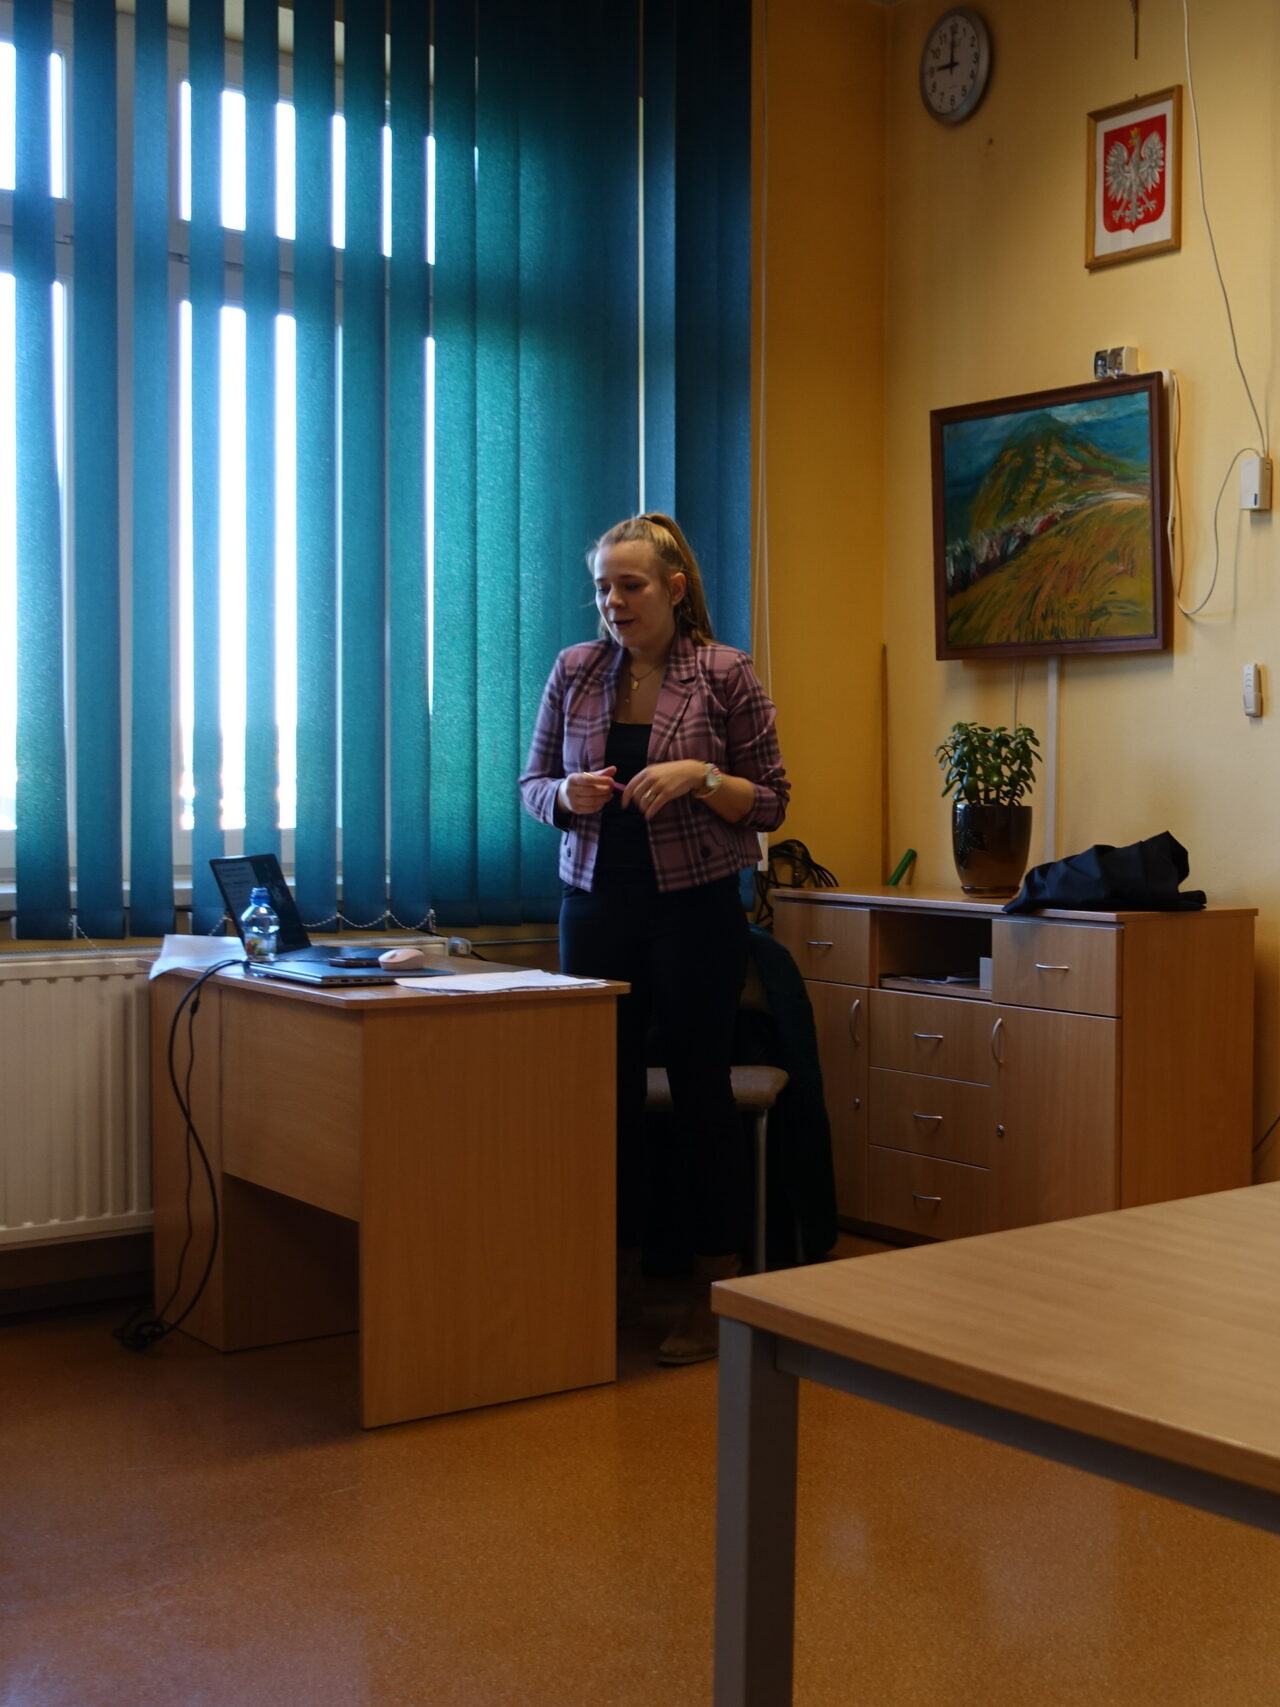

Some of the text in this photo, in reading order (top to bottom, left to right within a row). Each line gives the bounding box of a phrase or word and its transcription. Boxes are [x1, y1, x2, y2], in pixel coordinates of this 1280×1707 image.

[970, 36, 975, 47] 2
[973, 51, 978, 64] 3
[962, 85, 967, 96] 5
[950, 95, 955, 106] 6
